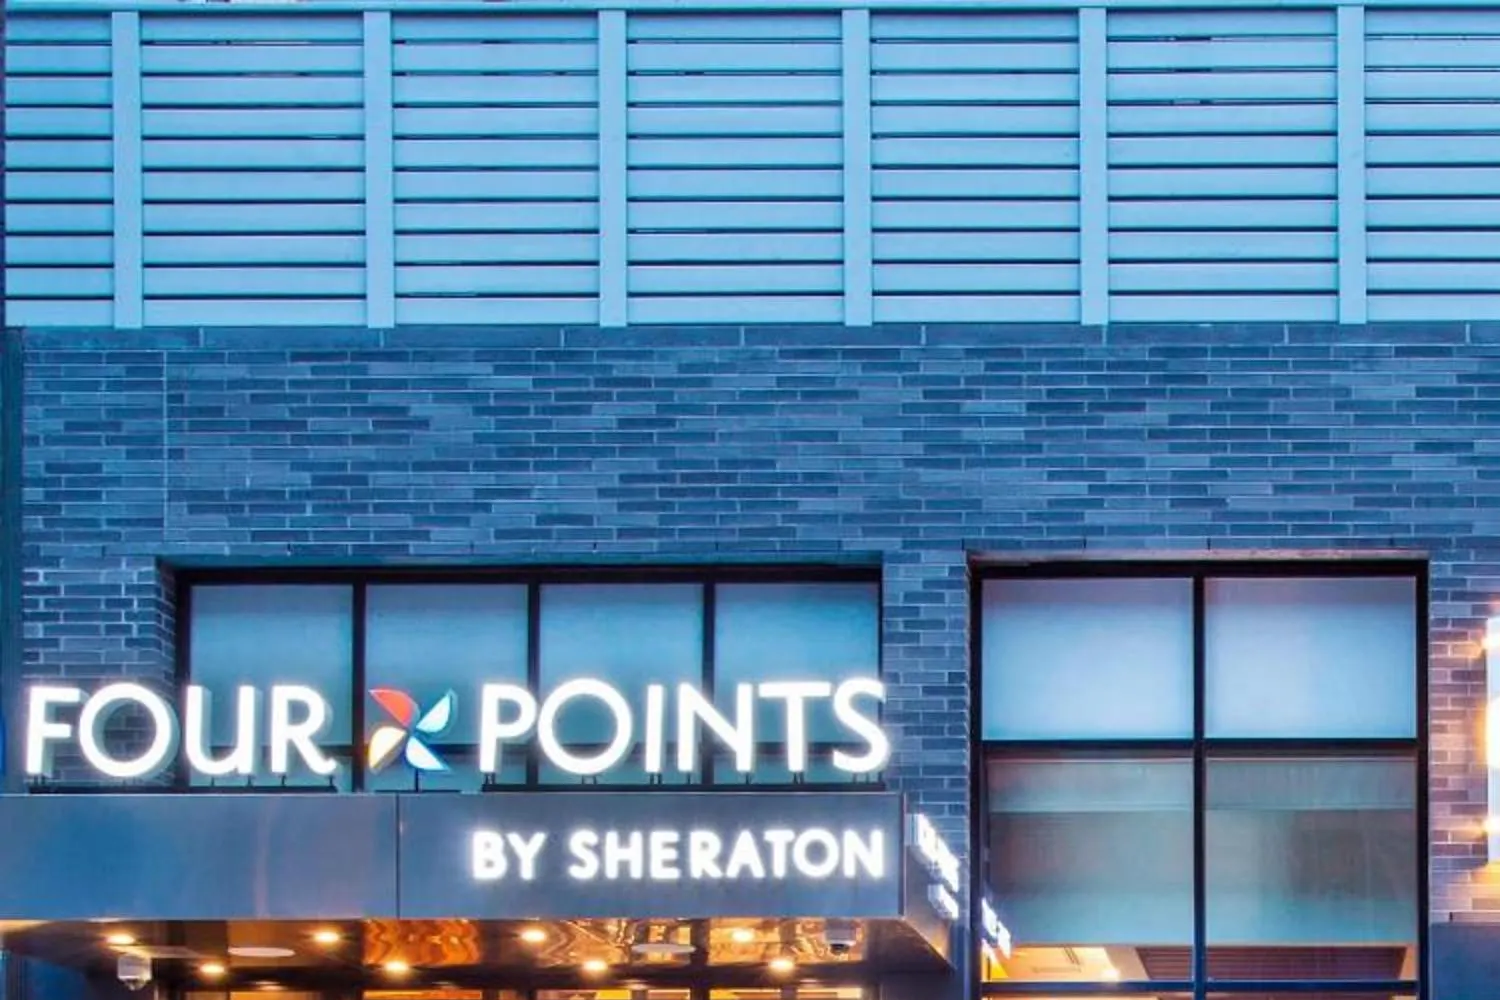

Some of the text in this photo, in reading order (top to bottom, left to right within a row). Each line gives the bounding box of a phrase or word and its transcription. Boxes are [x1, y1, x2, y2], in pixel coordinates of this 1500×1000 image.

[26, 676, 890, 777] FOUR POINTS
[470, 829, 546, 880] BY
[568, 827, 886, 879] SHERATON
